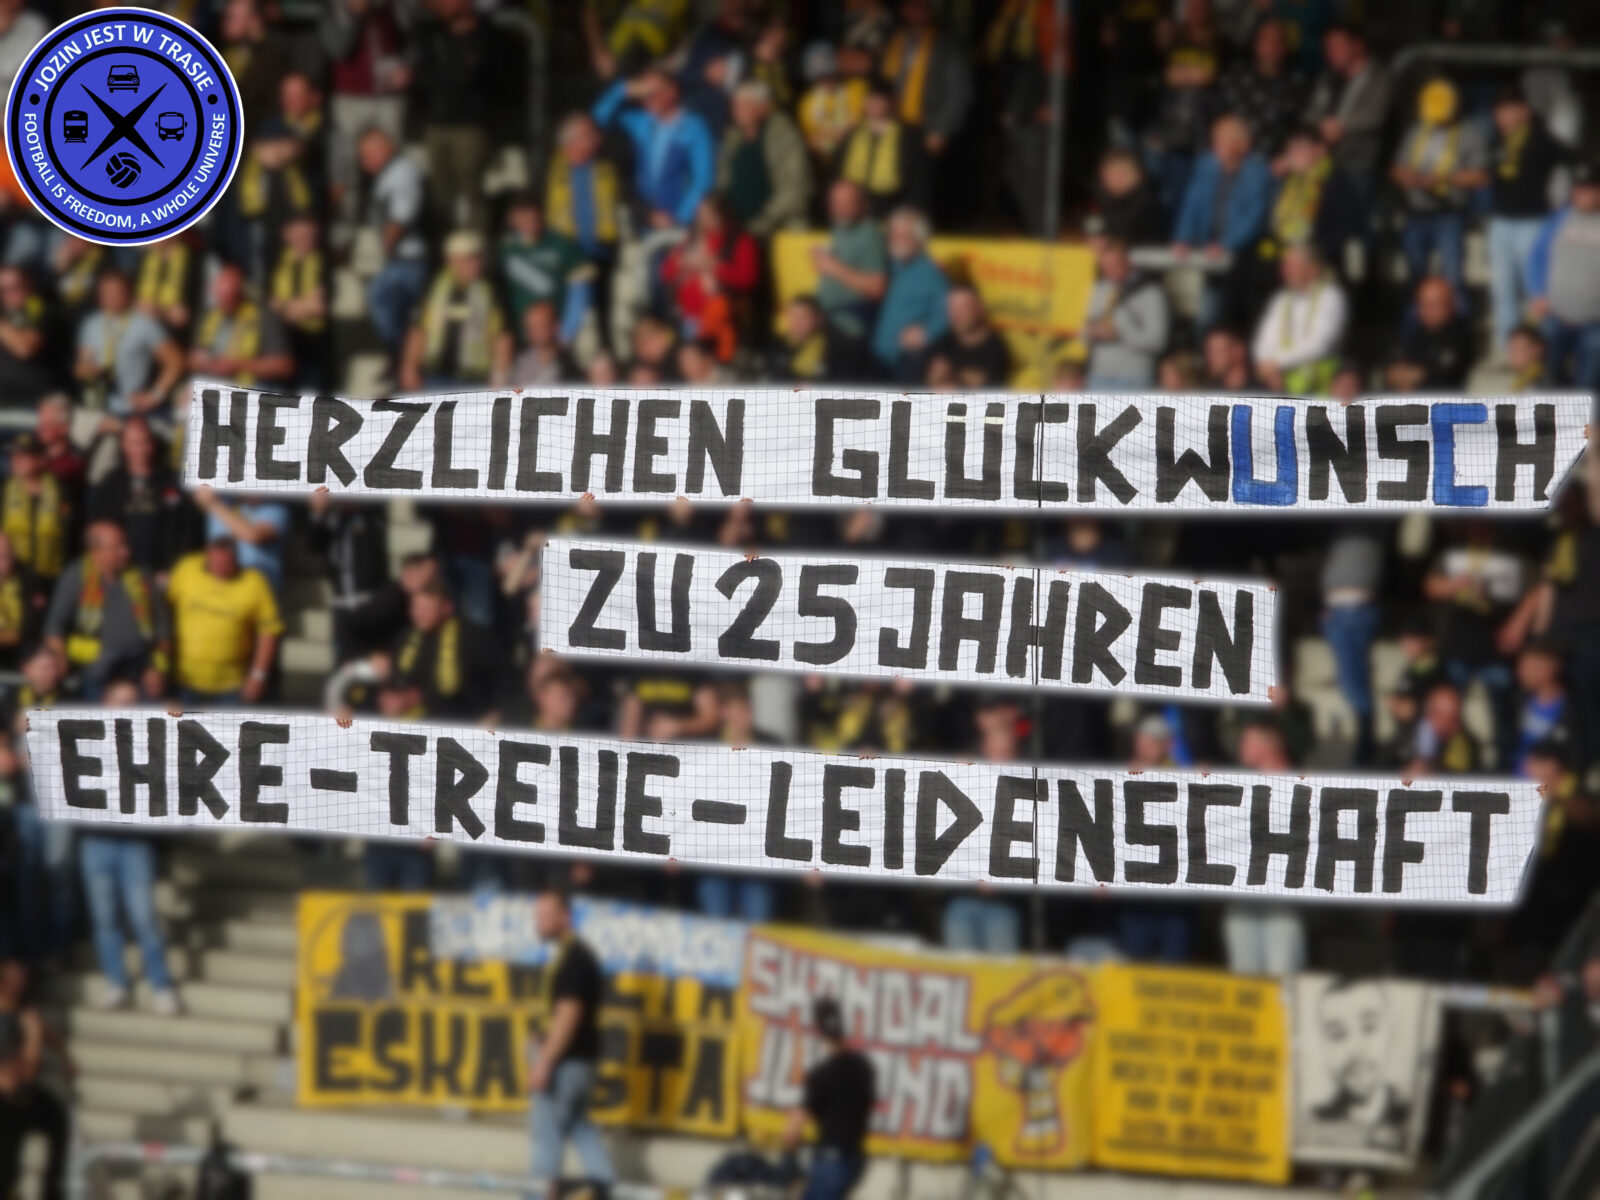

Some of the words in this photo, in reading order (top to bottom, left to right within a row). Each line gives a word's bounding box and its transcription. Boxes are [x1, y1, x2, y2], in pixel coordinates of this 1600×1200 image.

[198, 389, 746, 496] HERZLICHEN
[812, 400, 1556, 506] GLÜCKWUNSCH
[568, 549, 695, 653] ZU
[714, 558, 859, 665] 25
[877, 567, 1254, 695] JAHREN
